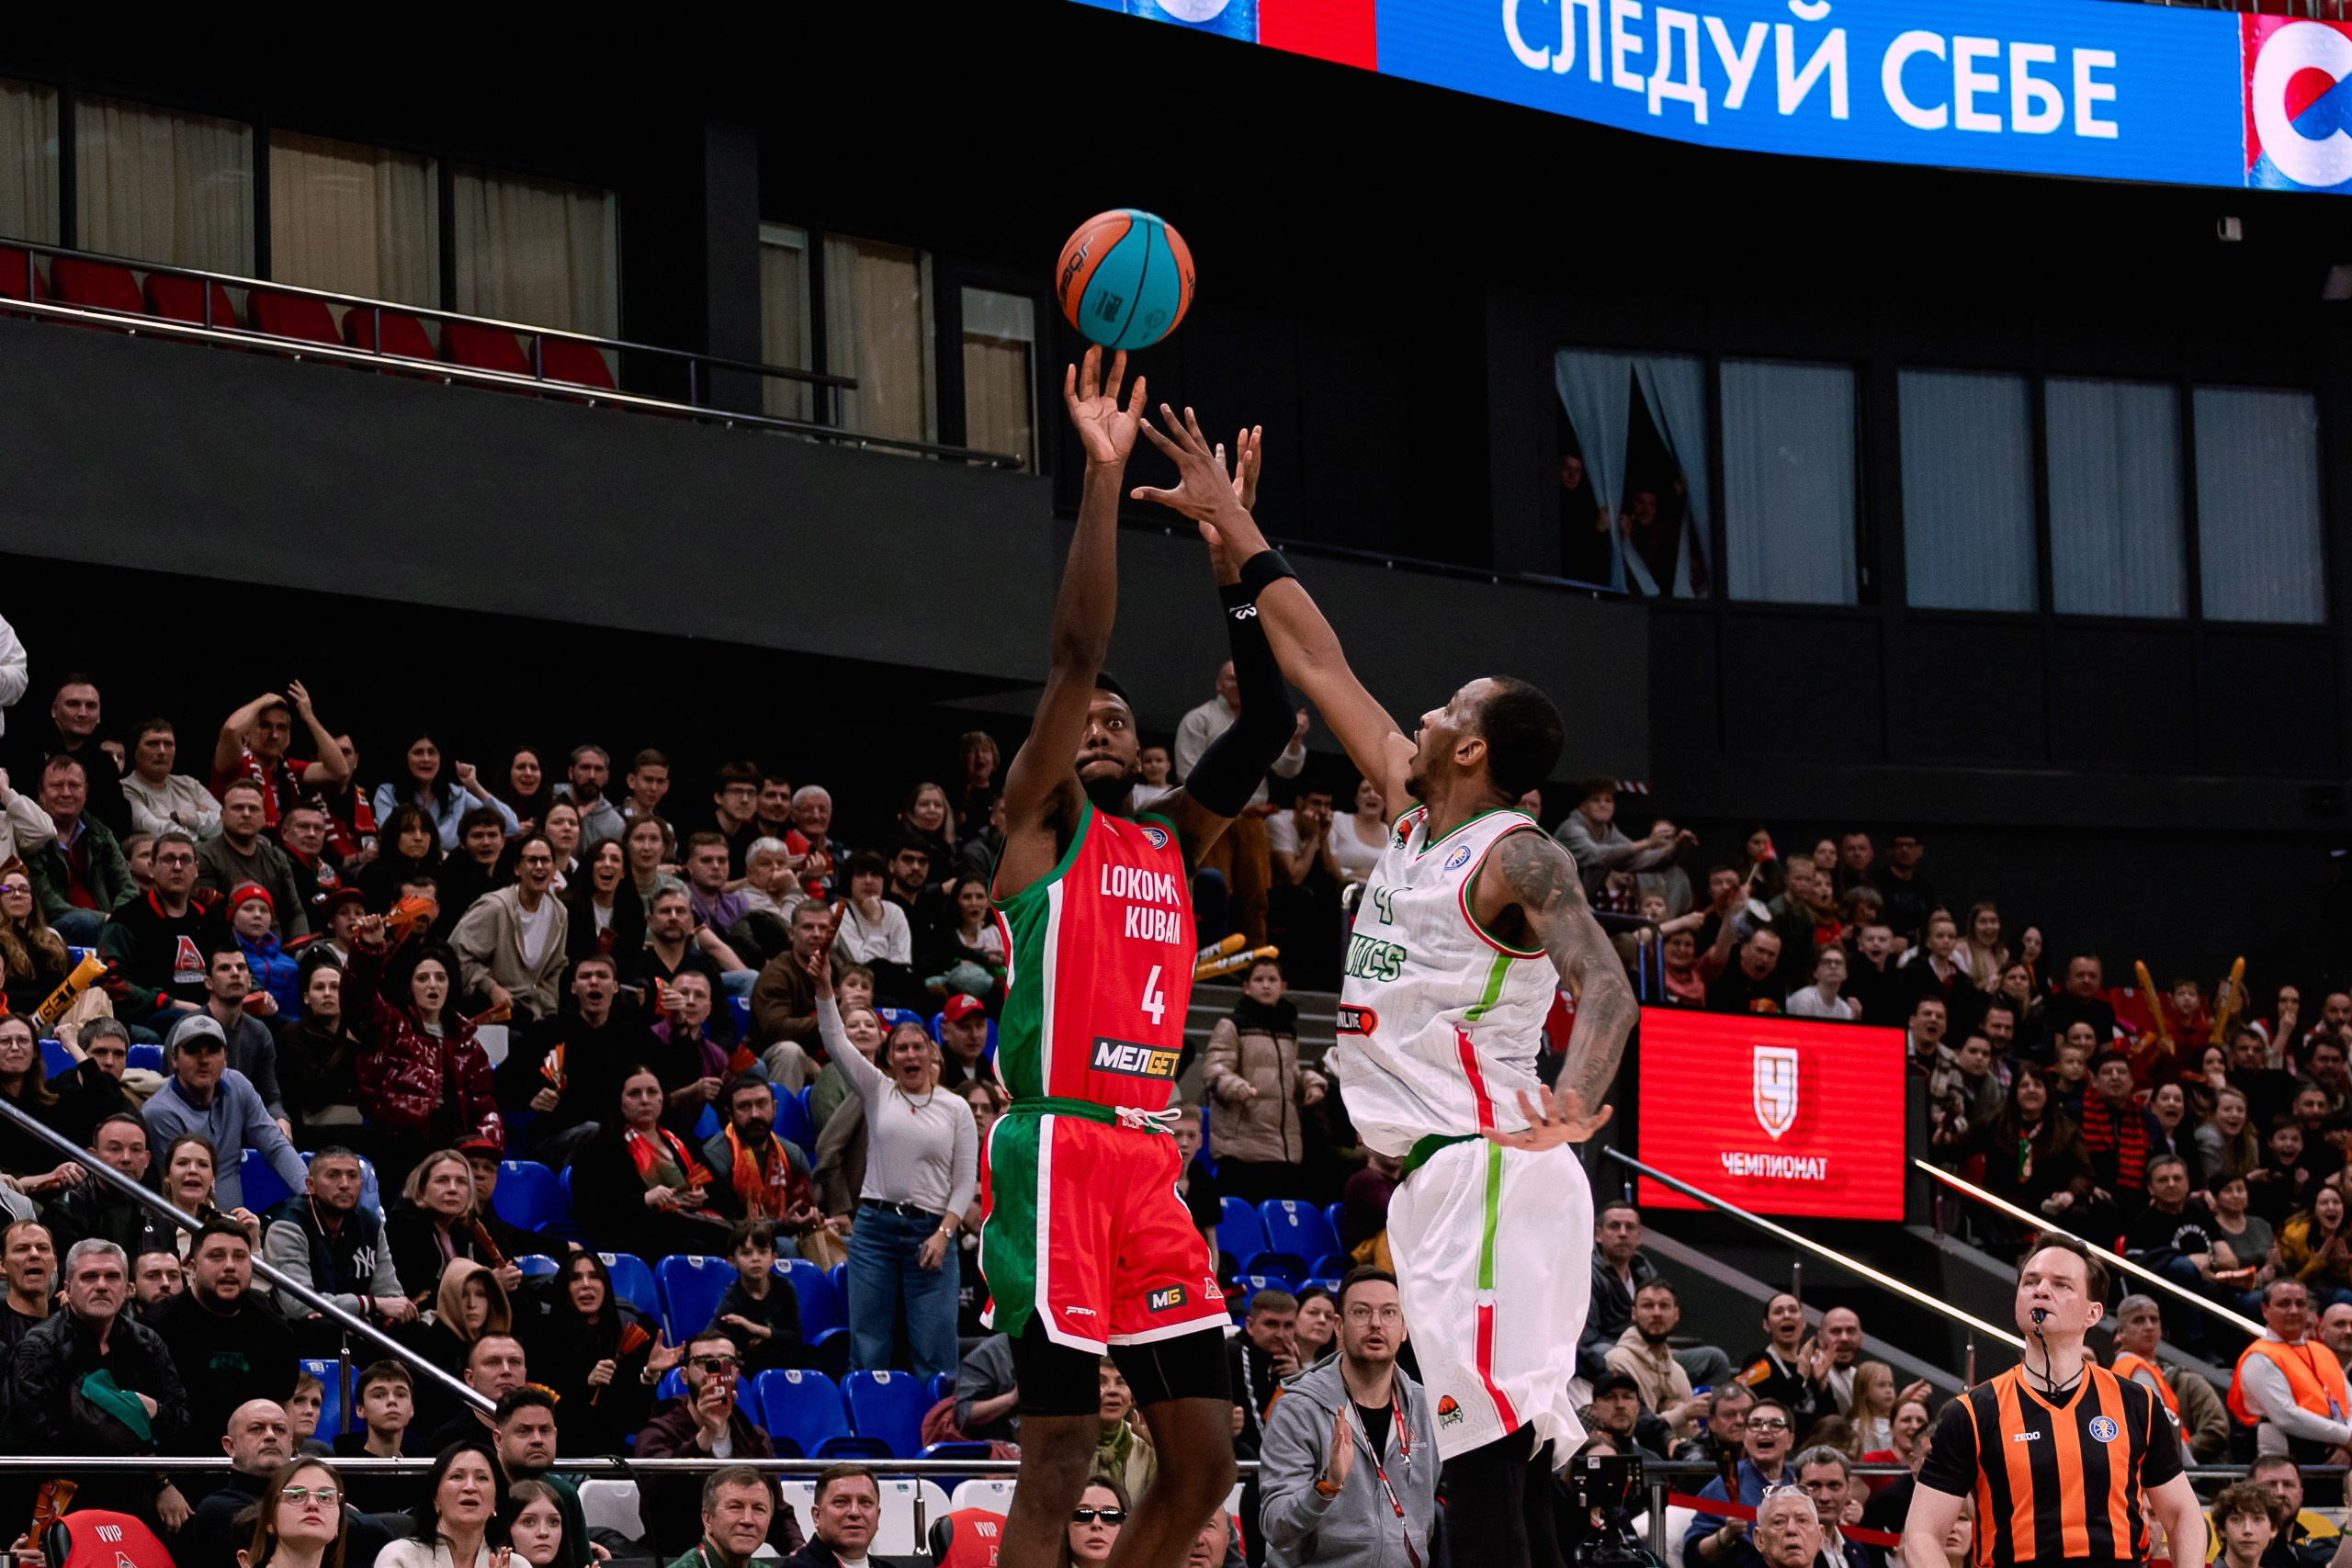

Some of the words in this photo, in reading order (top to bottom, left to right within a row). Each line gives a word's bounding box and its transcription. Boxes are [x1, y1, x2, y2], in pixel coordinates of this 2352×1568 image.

[1501, 0, 1849, 124] СЛЕДУЙ
[1881, 30, 2120, 140] СЕБЕ
[1101, 863, 1181, 907] LOKOM
[1141, 965, 1165, 1025] 4
[1721, 1152, 1828, 1180] ЧЕМПИОНАТ
[353, 1245, 377, 1280] NY
[2013, 1430, 2041, 1442] ZEDO
[95, 1525, 123, 1542] VVIP
[974, 1521, 998, 1537] VVIP
